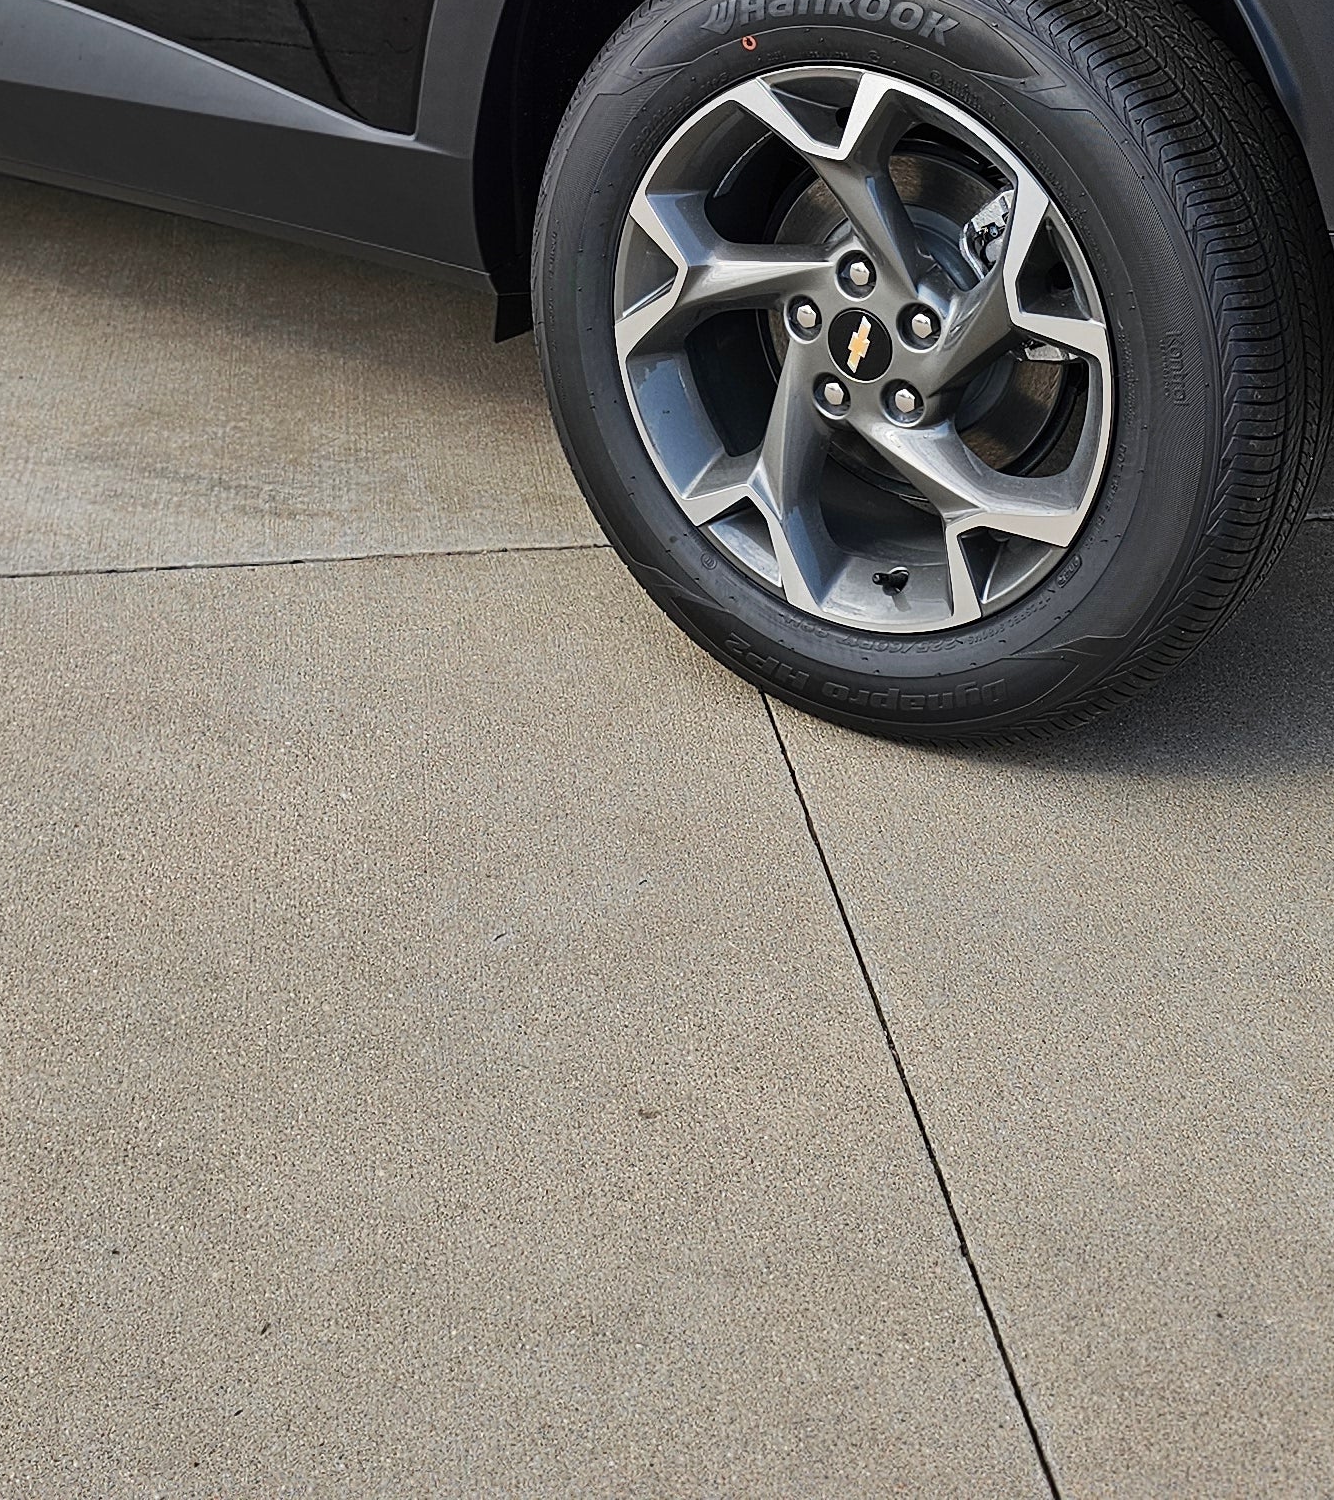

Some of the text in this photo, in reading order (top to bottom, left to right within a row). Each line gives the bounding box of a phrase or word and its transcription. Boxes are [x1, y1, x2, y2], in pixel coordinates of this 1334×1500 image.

[1166, 330, 1189, 406] Kontrol
[724, 631, 1007, 711] Dynapro HP2
